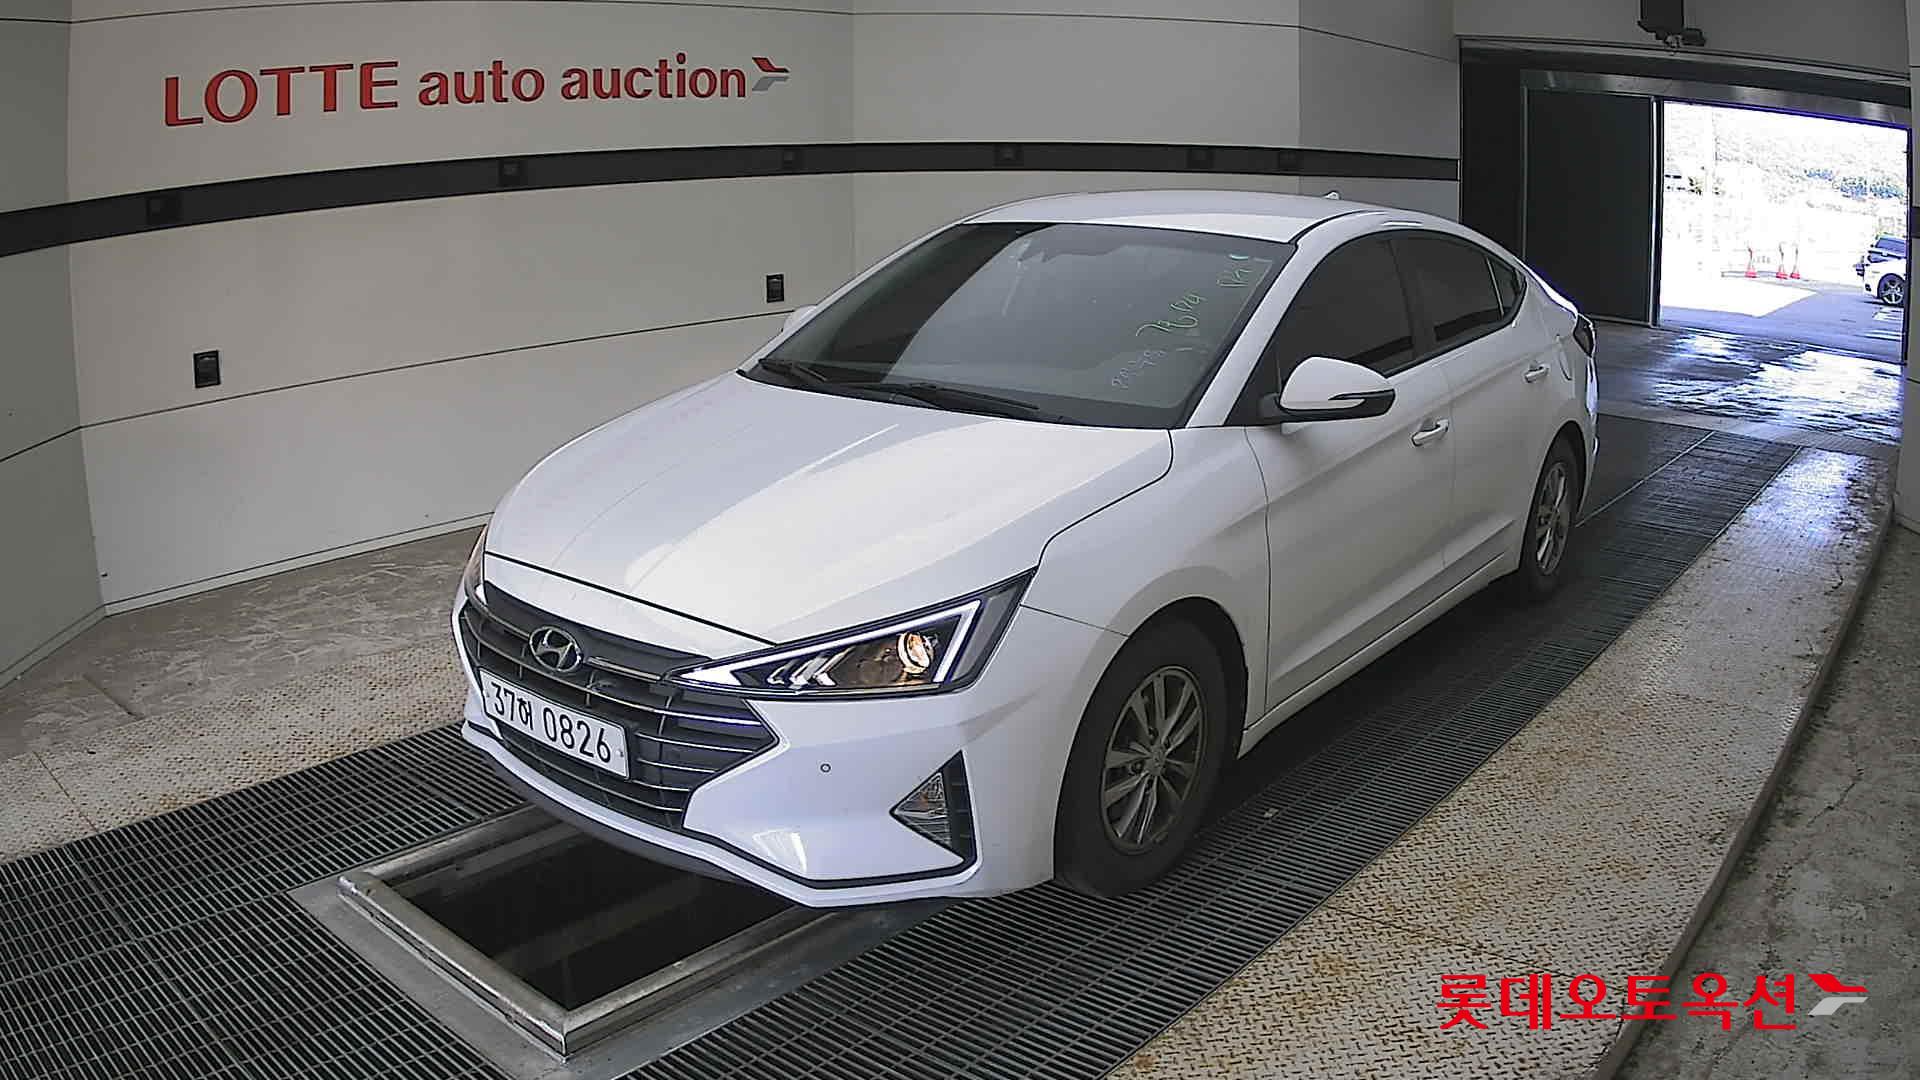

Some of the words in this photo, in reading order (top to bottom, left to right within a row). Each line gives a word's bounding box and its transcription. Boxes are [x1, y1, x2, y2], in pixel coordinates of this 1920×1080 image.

[165, 61, 398, 127] LOTTE
[418, 60, 545, 106] auto
[561, 52, 746, 99] auction
[491, 681, 533, 731] 37허
[543, 706, 612, 764] 0826
